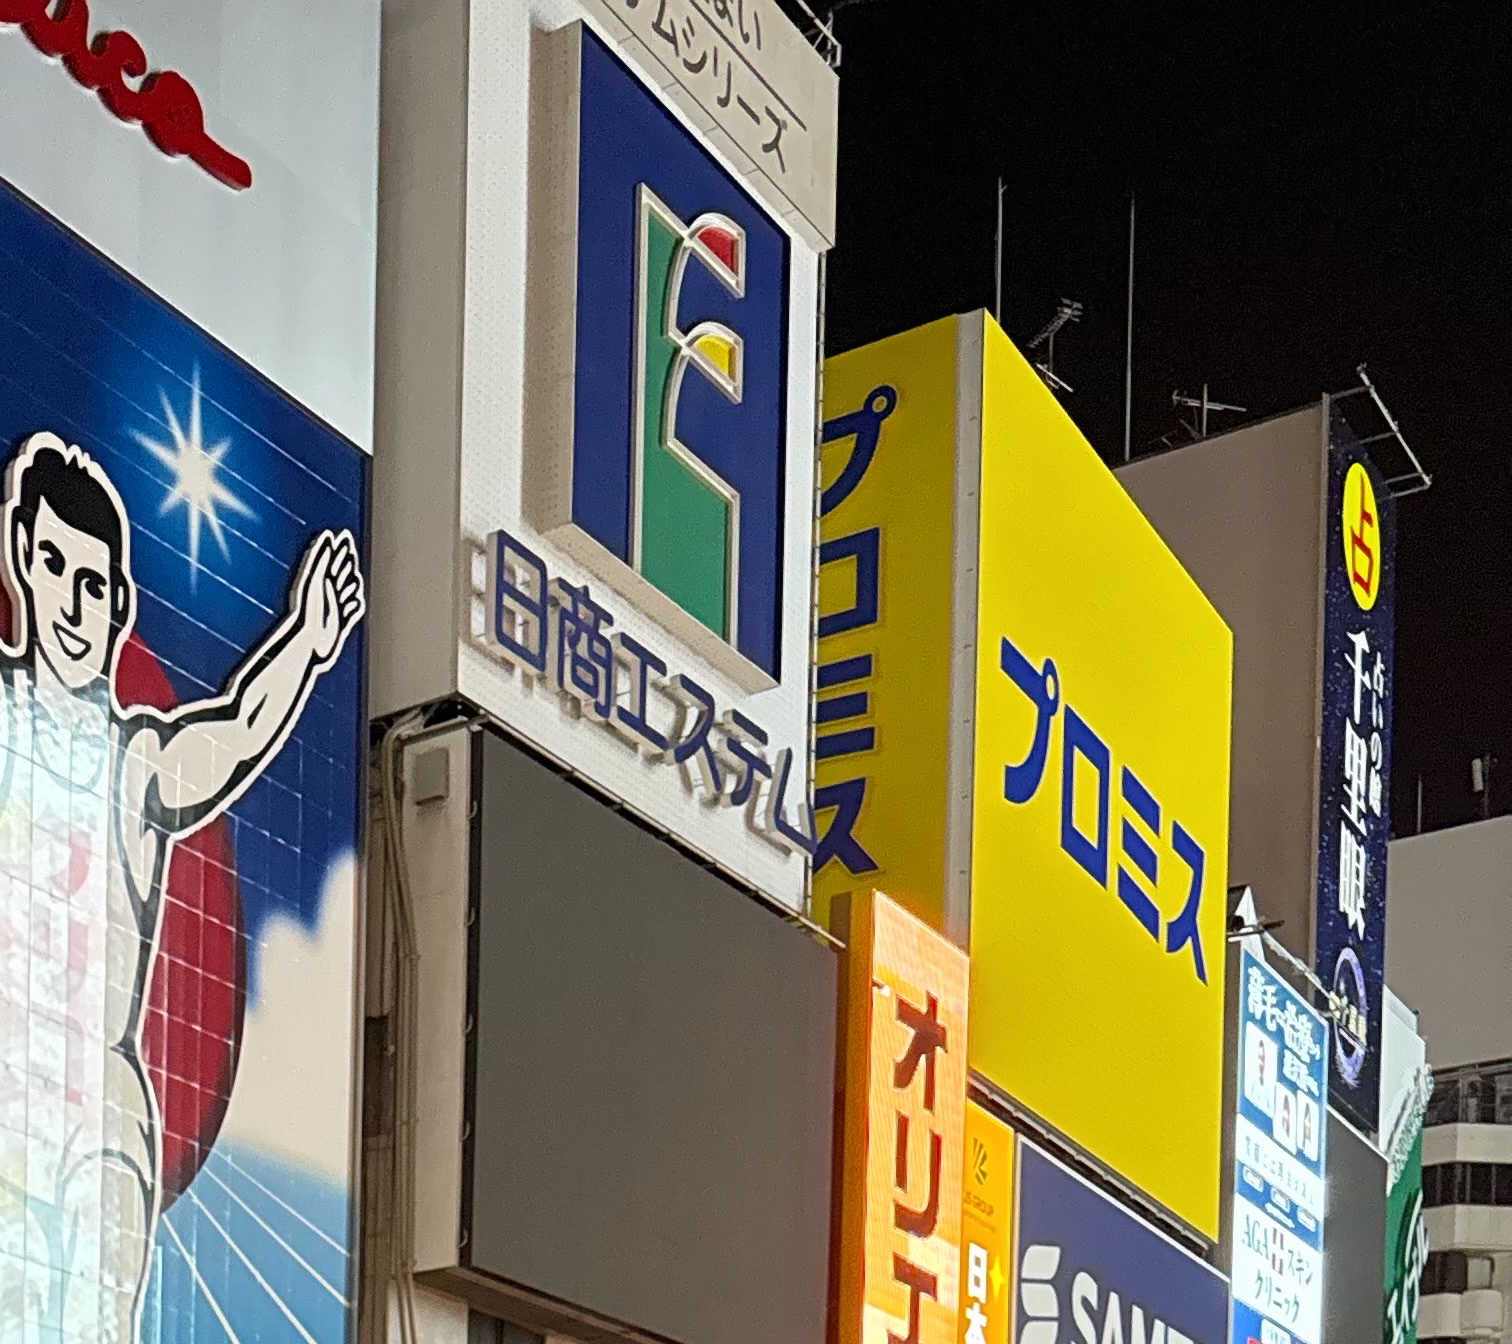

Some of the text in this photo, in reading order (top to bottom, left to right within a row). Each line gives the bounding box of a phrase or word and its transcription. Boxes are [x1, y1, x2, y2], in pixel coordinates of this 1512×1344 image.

[486, 528, 816, 857] 日商エステム
[999, 635, 1209, 986] プロミス
